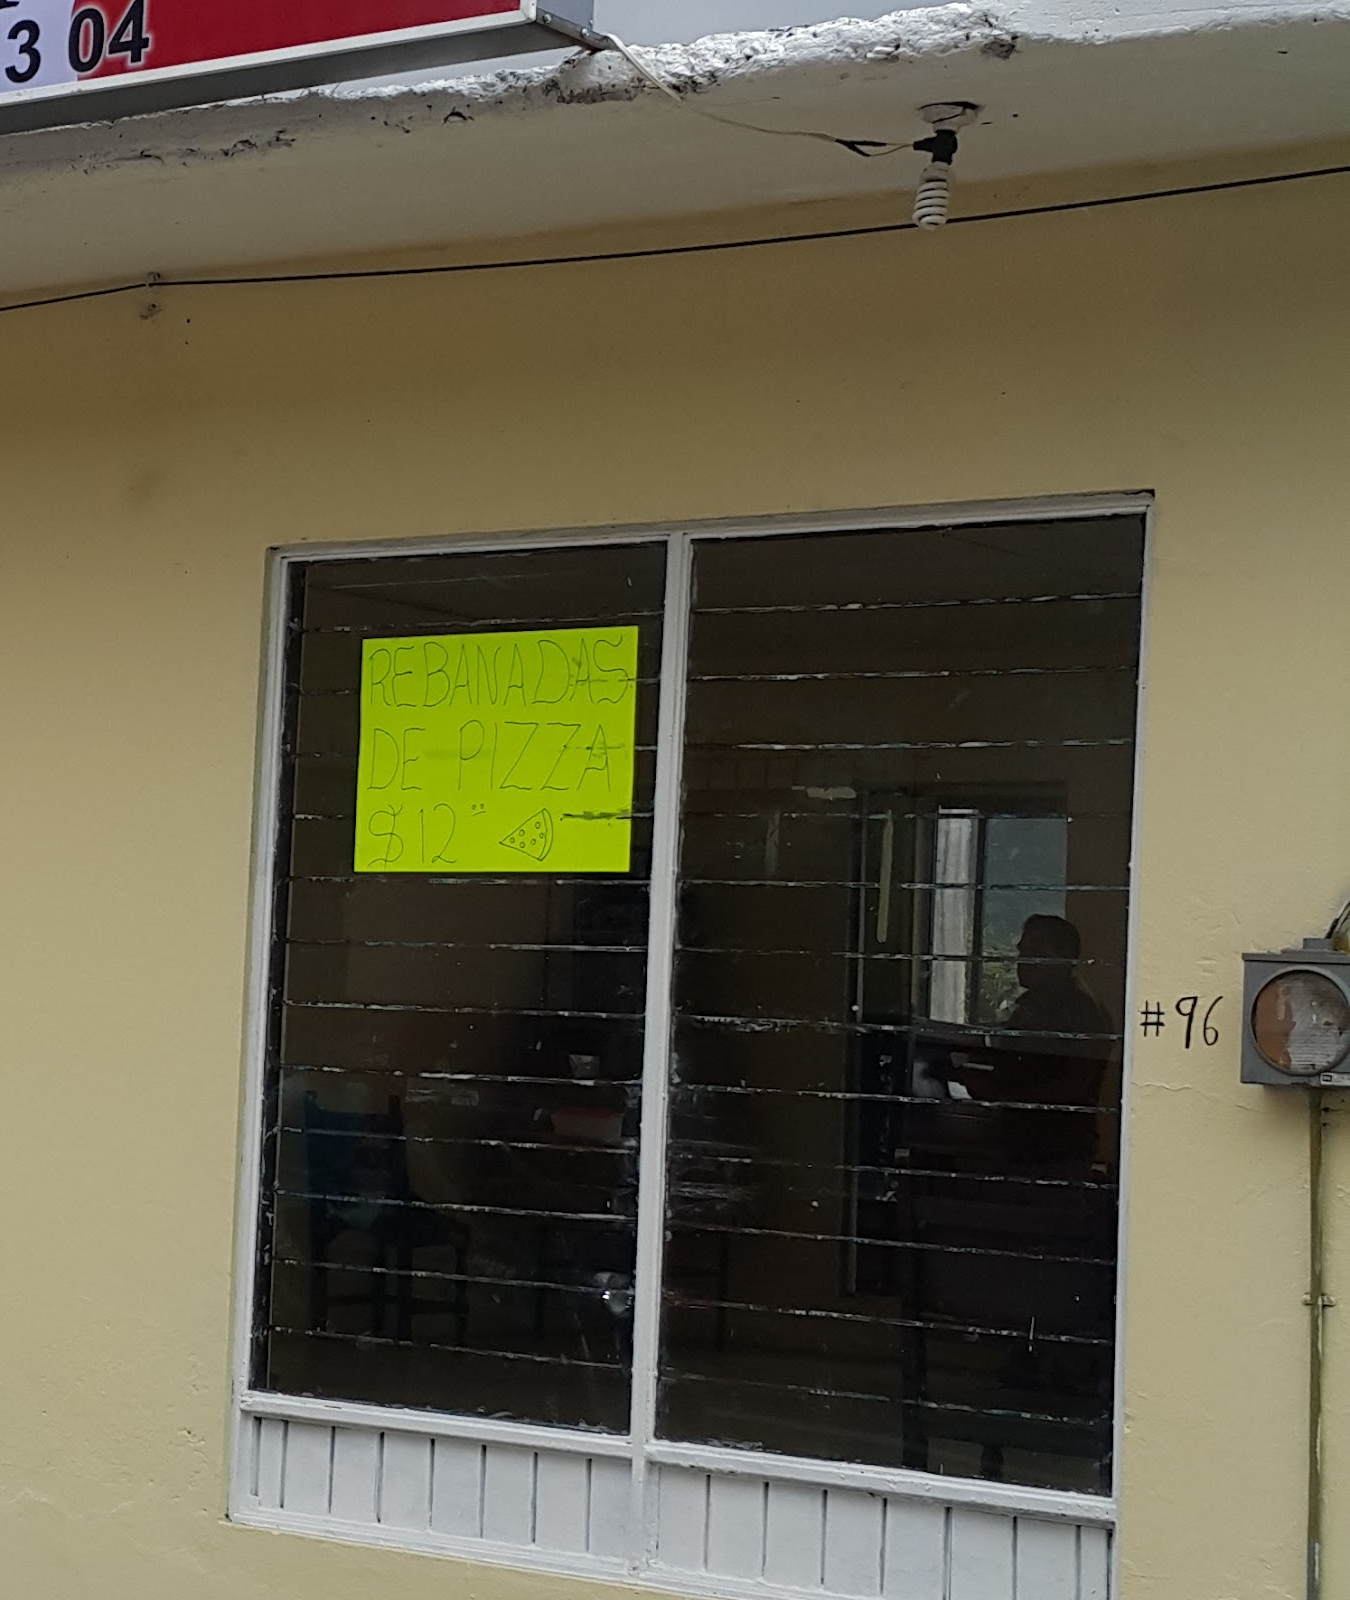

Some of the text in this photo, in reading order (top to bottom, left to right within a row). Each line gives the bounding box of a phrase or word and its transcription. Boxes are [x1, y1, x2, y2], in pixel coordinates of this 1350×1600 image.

[368, 636, 629, 707] REBANADAS
[367, 719, 611, 792] DE PIZZA
[1140, 996, 1224, 1049] #96
